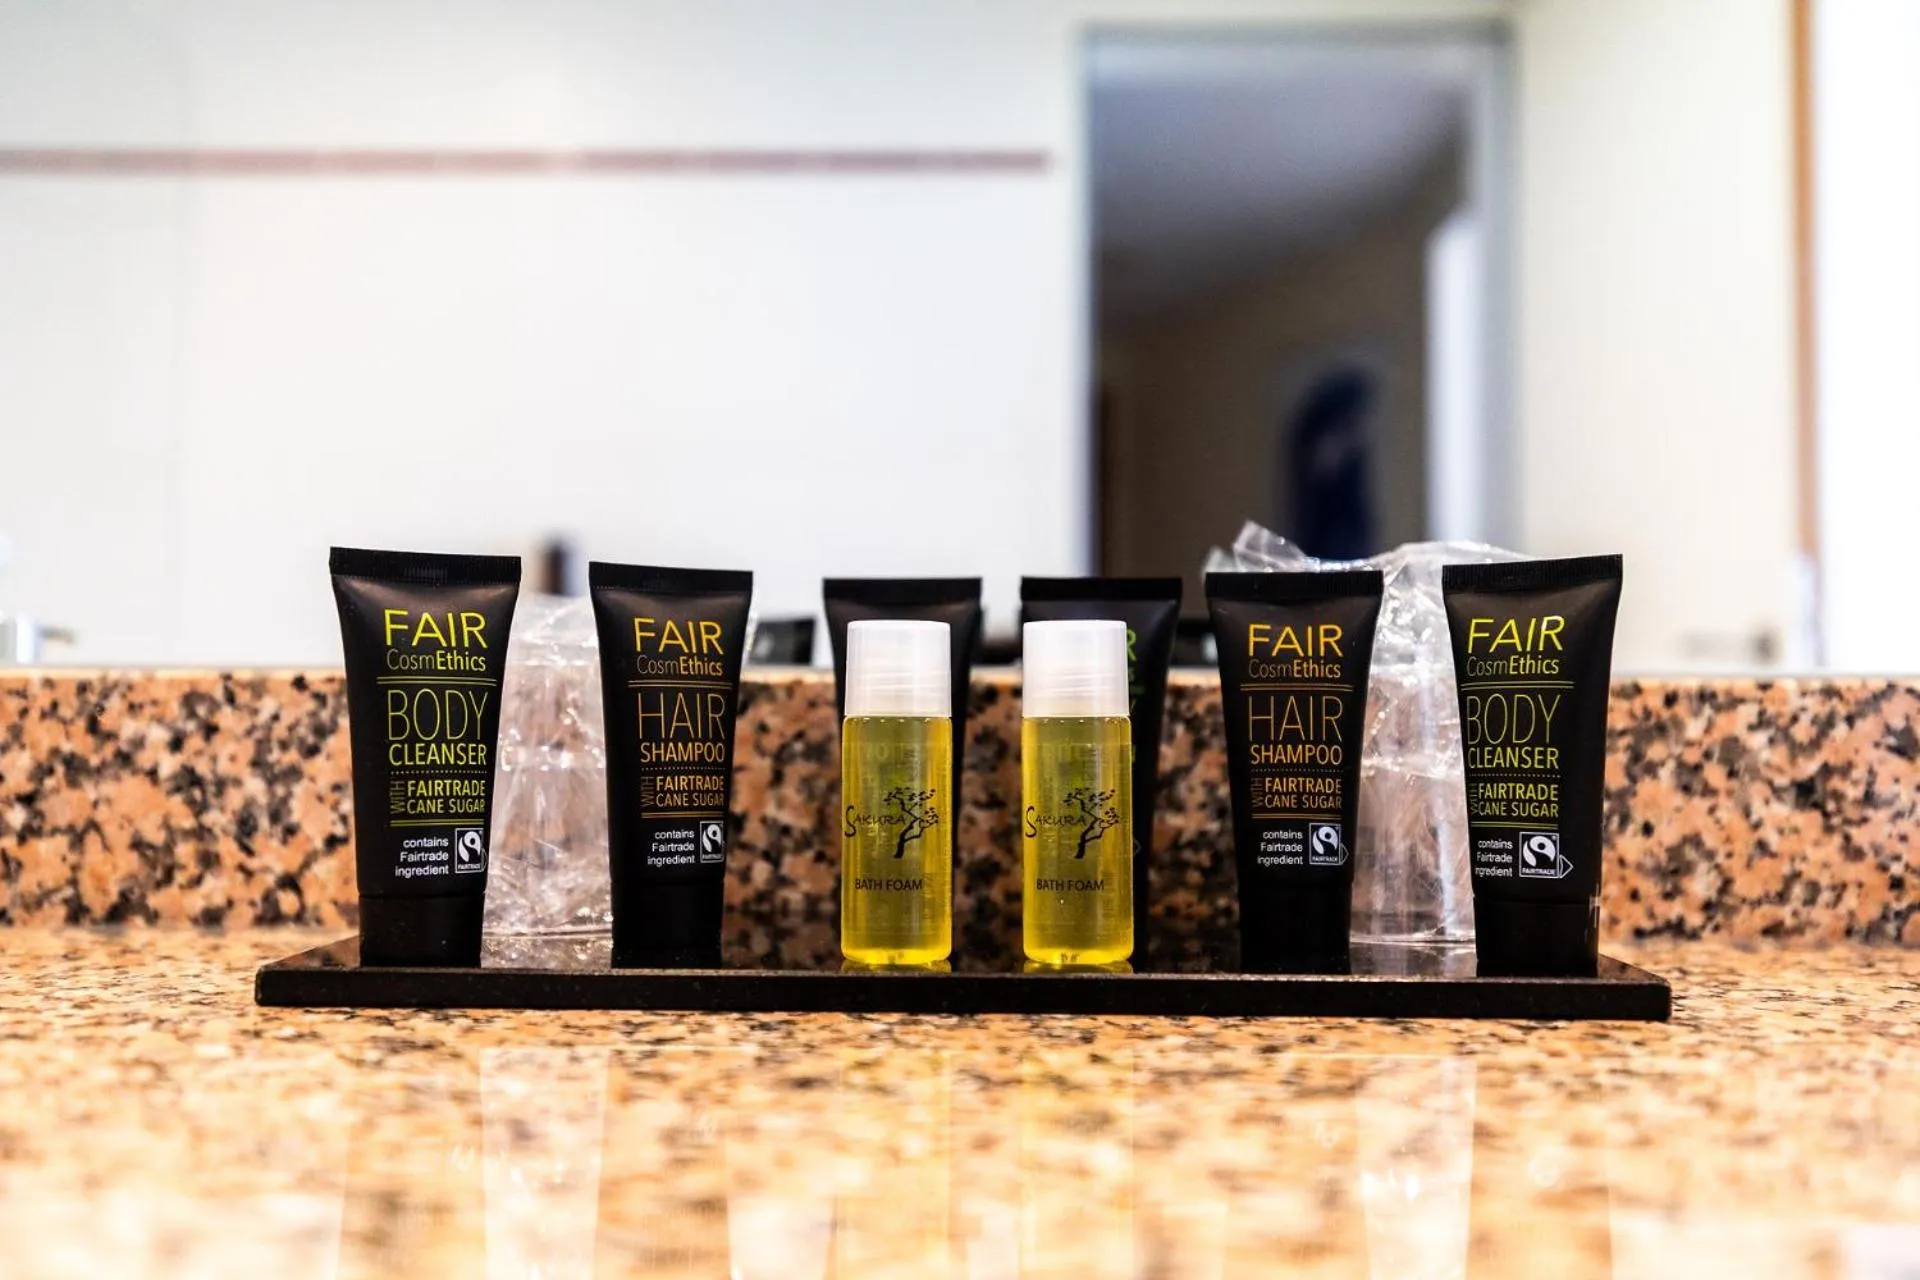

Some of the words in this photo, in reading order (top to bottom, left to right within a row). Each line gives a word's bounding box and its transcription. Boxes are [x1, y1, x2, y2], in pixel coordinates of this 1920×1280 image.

[384, 608, 488, 649] FAIR
[634, 617, 724, 655] FAIR
[1467, 615, 1565, 654] FAIR
[1248, 623, 1343, 657] FAIR
[386, 648, 487, 672] CosmEthics
[636, 654, 724, 676] CosmEthics
[1248, 658, 1342, 679] CosmEthics
[1466, 653, 1560, 677] CosmEthics
[387, 688, 489, 742] BODY
[637, 692, 725, 740] HAIR
[1248, 695, 1343, 741] HAIR
[1466, 693, 1561, 745] BODY
[388, 743, 487, 766] CLEANSER
[640, 741, 725, 763] SHAMPOO
[1250, 744, 1343, 765] SHAMPOO
[1467, 746, 1560, 769] CLEANSER
[407, 779, 486, 797] FAIRTRADE
[656, 775, 724, 791] FAIRTRADE
[1265, 777, 1342, 794] FAIRTRADE
[1478, 782, 1559, 801] FAIRTRADE
[389, 780, 406, 815] WITH
[406, 799, 445, 815] CANE
[448, 798, 485, 813] SUGAR
[656, 793, 689, 808] CANE
[692, 793, 724, 807] SUGAR
[1265, 794, 1298, 809] CANE
[1302, 794, 1342, 809] SUGAR
[1478, 801, 1508, 816] CANE
[1511, 801, 1559, 818] SUGAR
[402, 837, 449, 848] contains
[654, 829, 695, 840] contains
[1262, 829, 1304, 840] contains
[652, 842, 695, 853] Fairtrade
[1260, 842, 1304, 853] Fairtrade
[1477, 838, 1514, 850] contains
[400, 851, 449, 863] Fairtrade
[647, 855, 695, 868] ingredient
[1257, 856, 1304, 868] ingredient
[395, 865, 449, 879] ingredient
[854, 878, 882, 890] BATH
[886, 878, 923, 891] FOAM
[1036, 878, 1064, 891] BATH
[1068, 878, 1105, 892] FOAM
